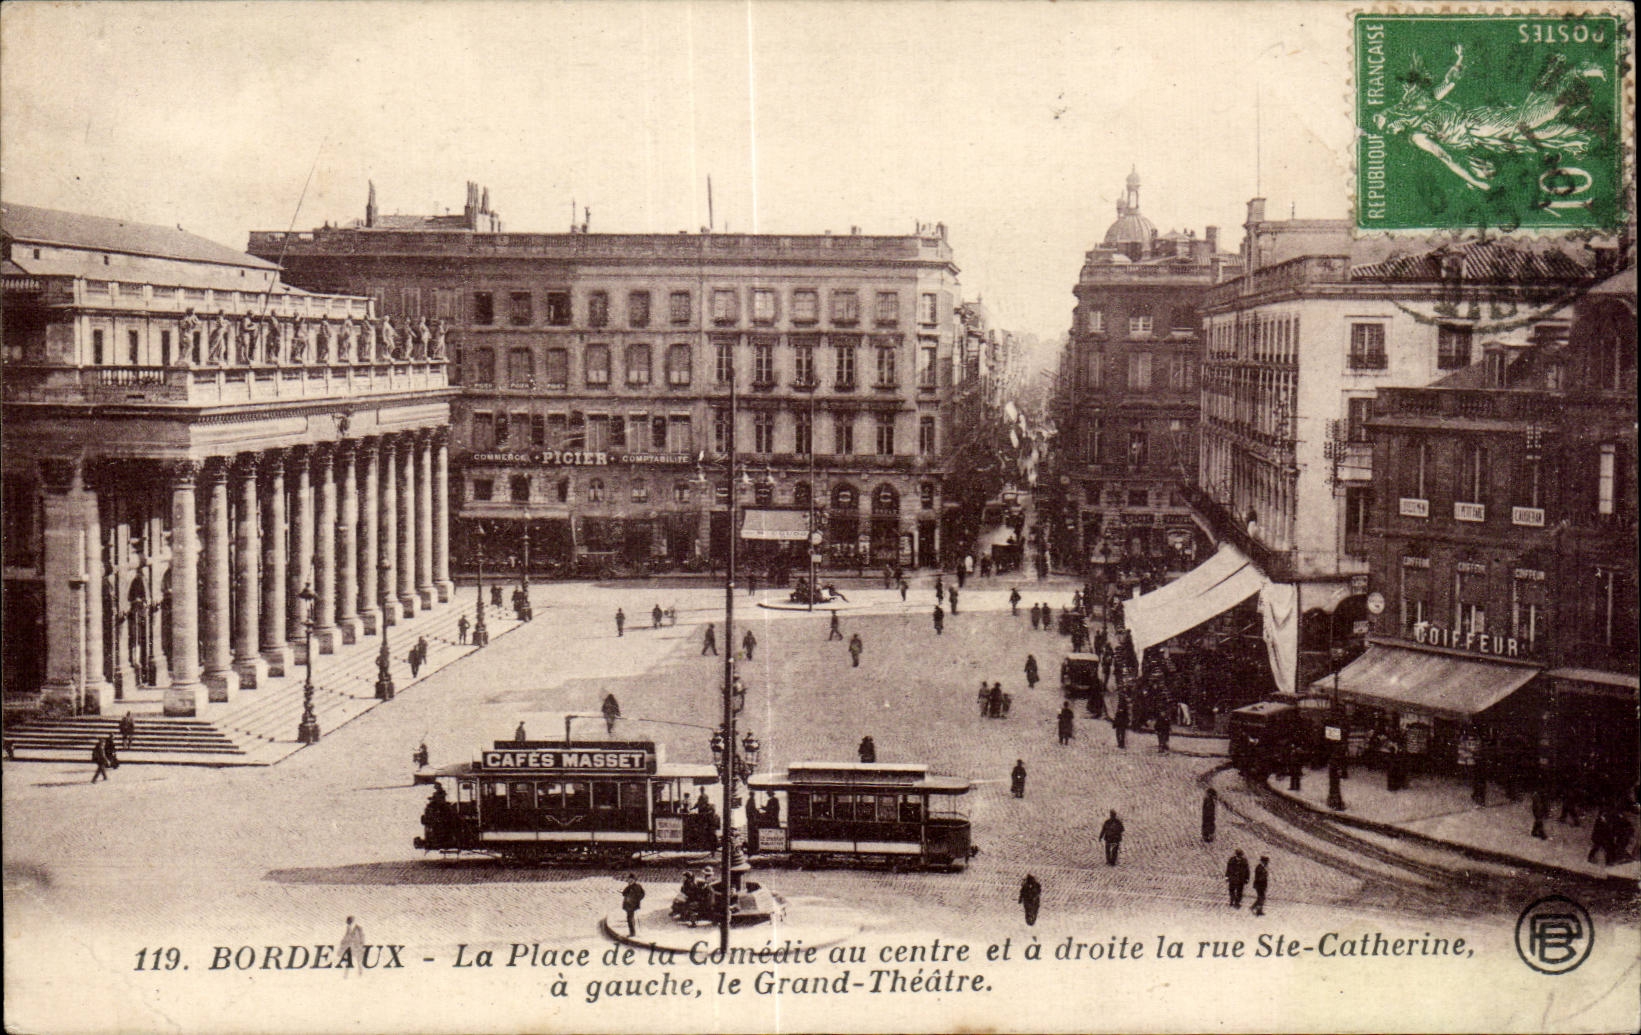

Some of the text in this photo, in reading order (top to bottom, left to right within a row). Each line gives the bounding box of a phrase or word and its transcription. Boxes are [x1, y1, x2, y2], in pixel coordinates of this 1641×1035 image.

[1518, 24, 1605, 43] POSTES
[1414, 624, 1518, 656] COIFFEUR
[486, 752, 643, 769] CAFÉS MASSET
